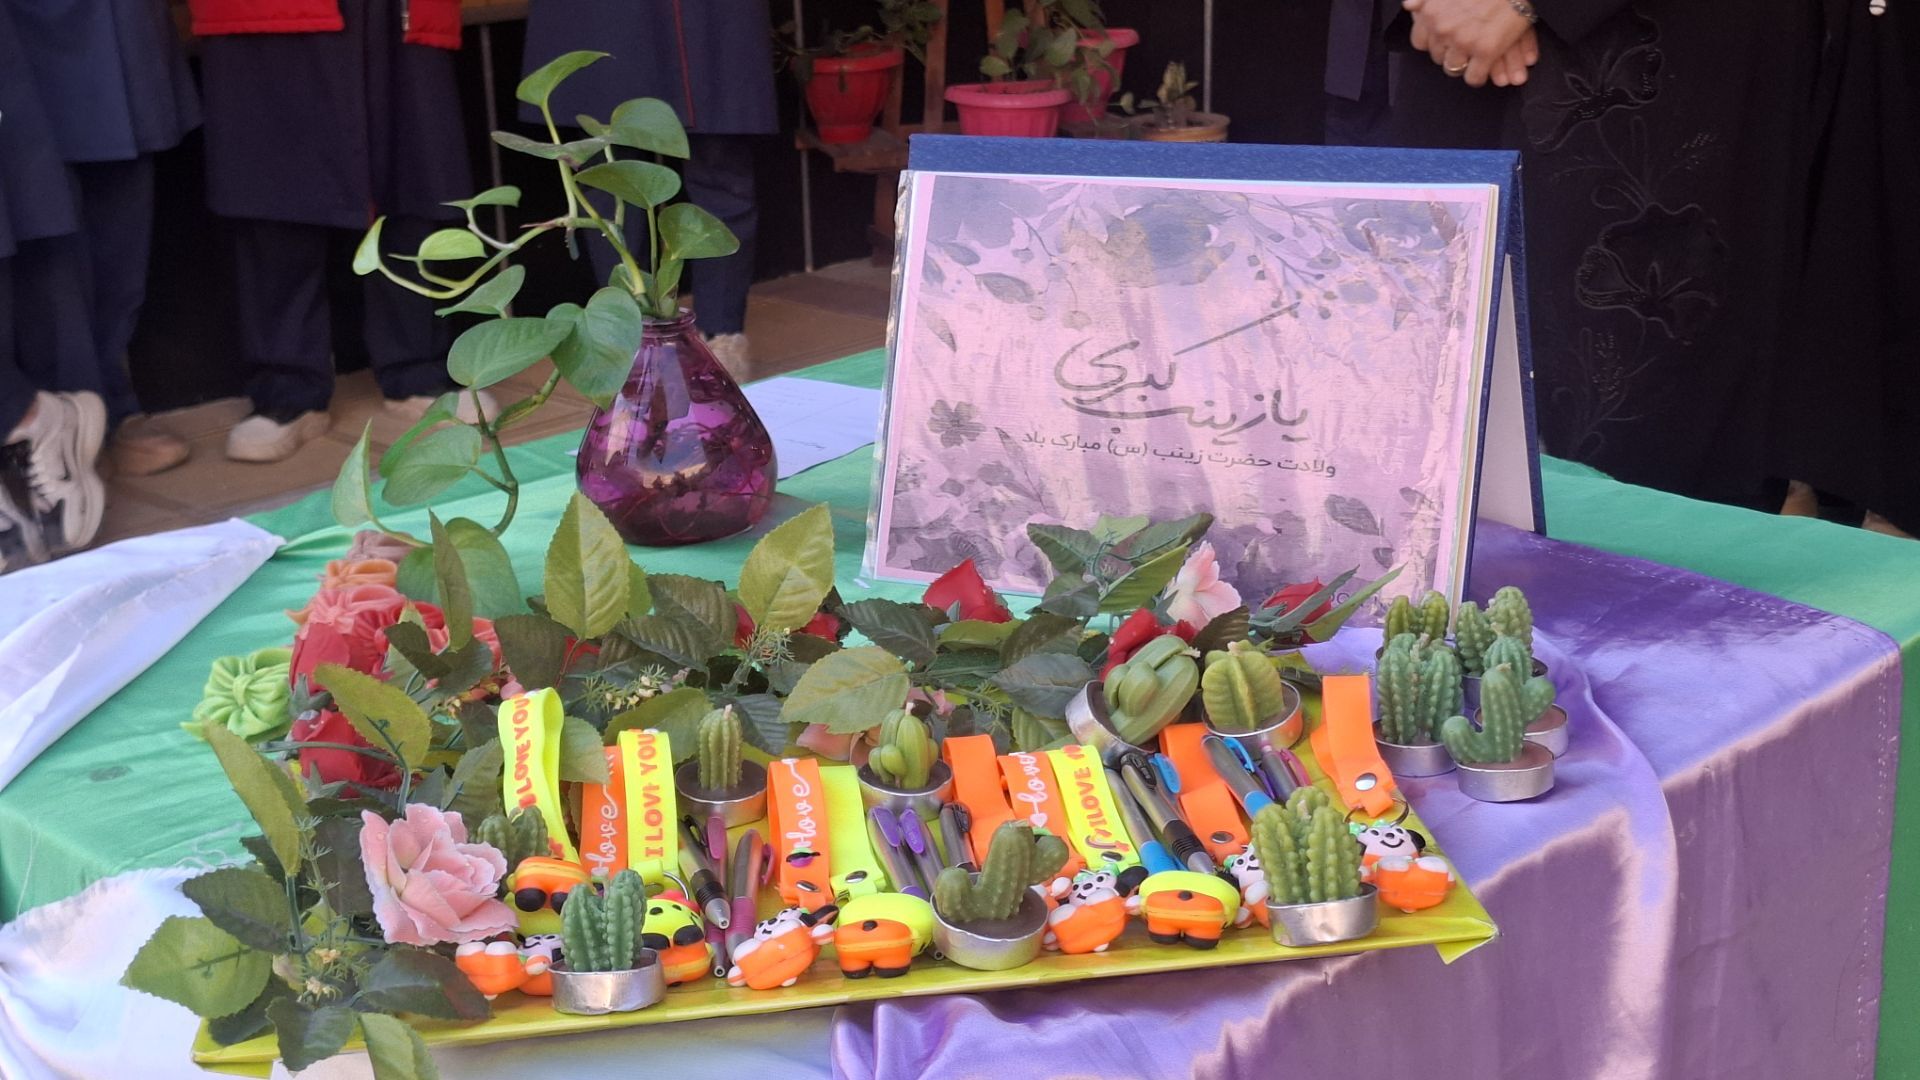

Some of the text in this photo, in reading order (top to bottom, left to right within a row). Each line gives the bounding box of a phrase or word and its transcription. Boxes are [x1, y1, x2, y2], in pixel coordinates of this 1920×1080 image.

[1022, 429, 1337, 478] ولادت حضرت زینب (س) مبارک باد
[514, 740, 533, 794] LOVE
[637, 732, 658, 776] YOU
[585, 799, 618, 864] love
[785, 782, 817, 840] love
[645, 846, 663, 858] I
